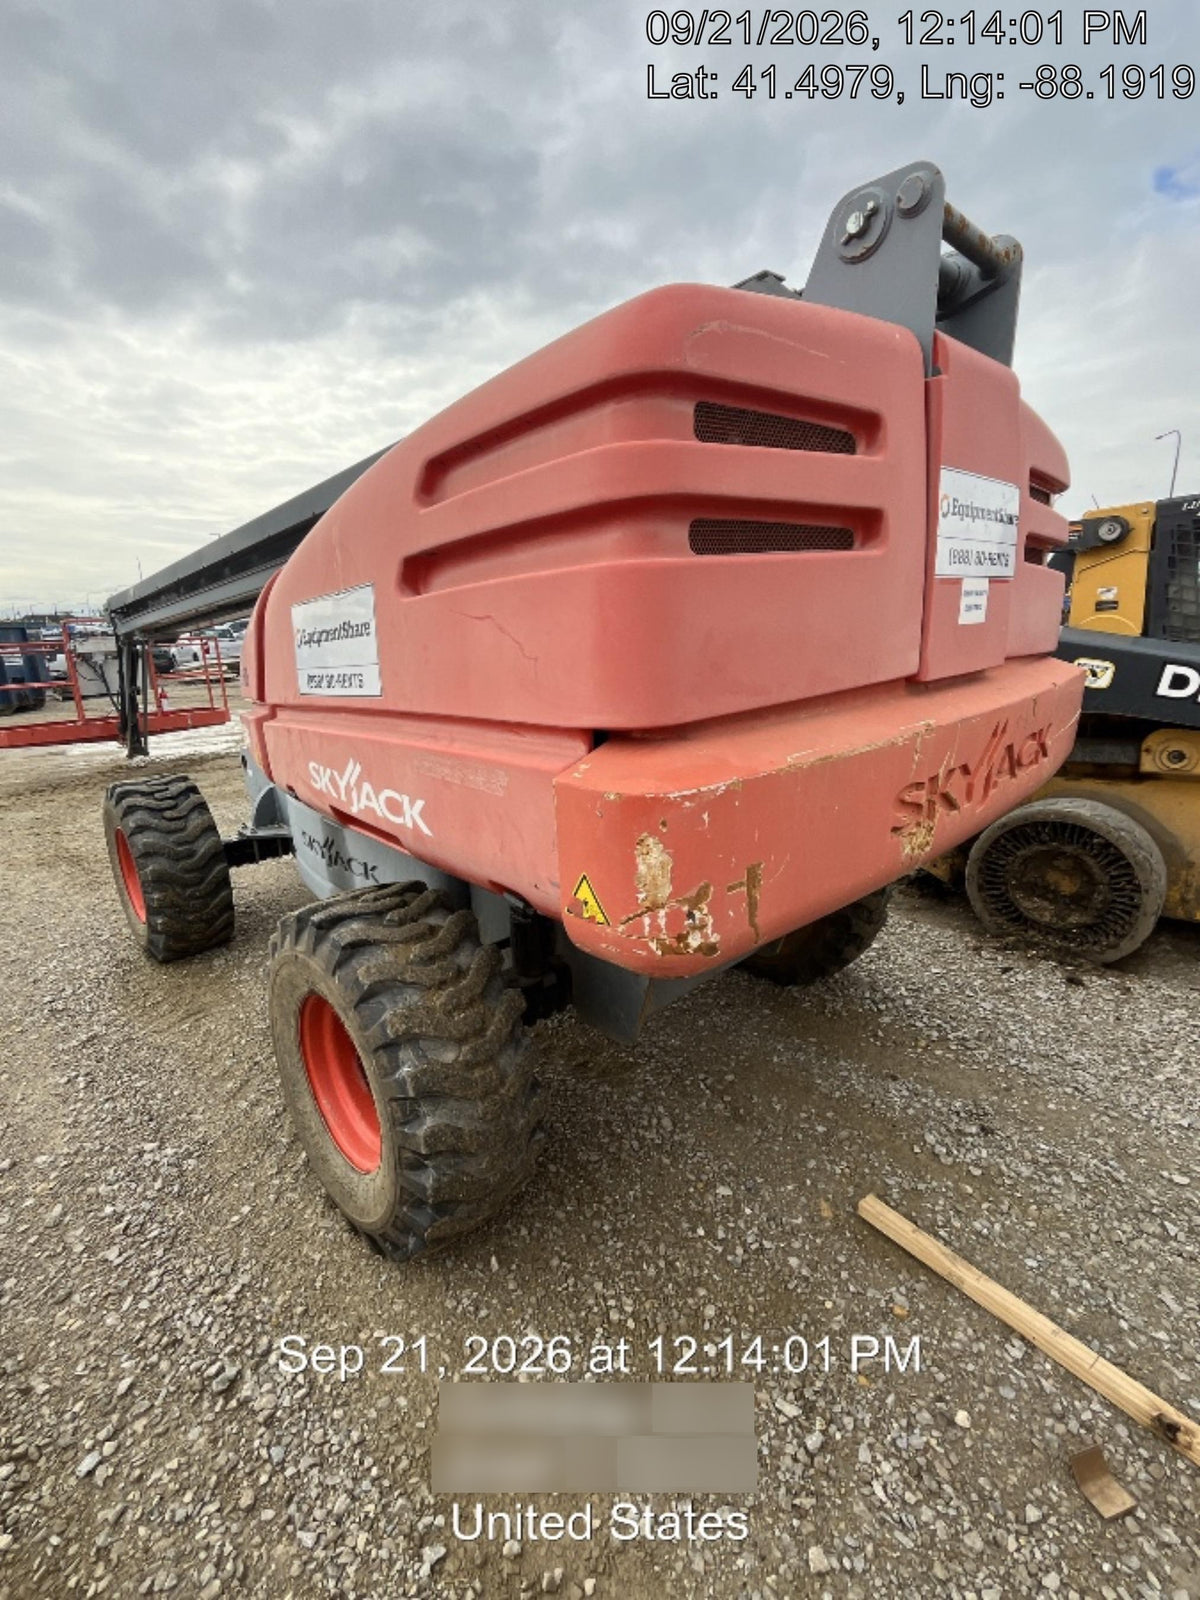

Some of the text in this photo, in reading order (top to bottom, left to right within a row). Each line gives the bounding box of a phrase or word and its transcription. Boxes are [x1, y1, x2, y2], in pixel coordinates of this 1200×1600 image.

[1156, 664, 1200, 704] D
[308, 758, 433, 837] SKYJACK
[890, 719, 1052, 836] SKYJACK
[302, 831, 379, 884] SKYJACK
